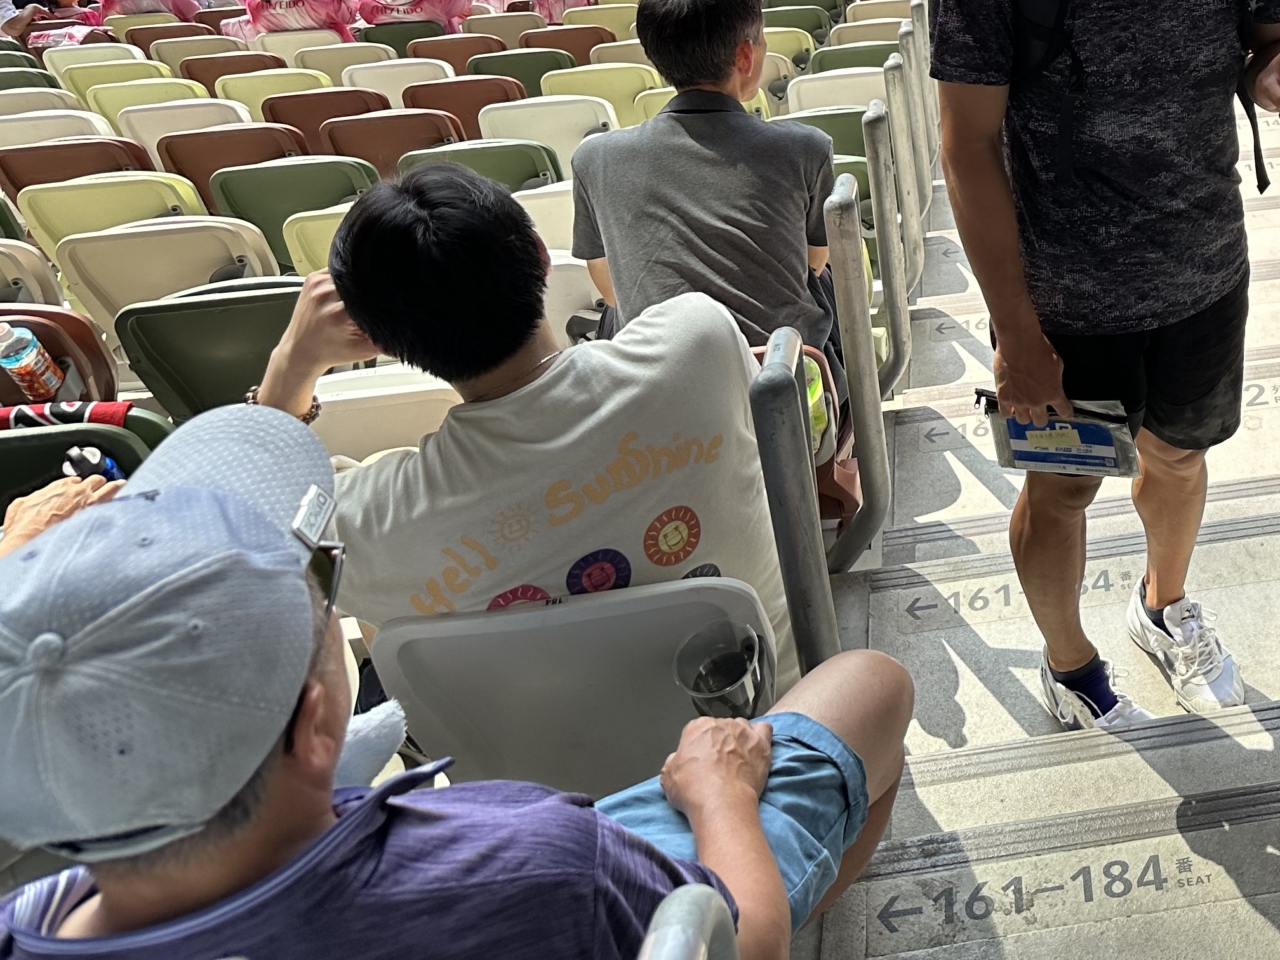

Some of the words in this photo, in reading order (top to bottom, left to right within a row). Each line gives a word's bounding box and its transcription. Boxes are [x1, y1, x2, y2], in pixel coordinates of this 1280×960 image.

[254, 0, 305, 11] SHISEIDO
[370, 5, 423, 15] SHISEIDO
[1243, 384, 1270, 407] 2
[1177, 873, 1212, 888] SEAT
[932, 854, 1168, 924] 161-184
[1175, 857, 1194, 874] 番
